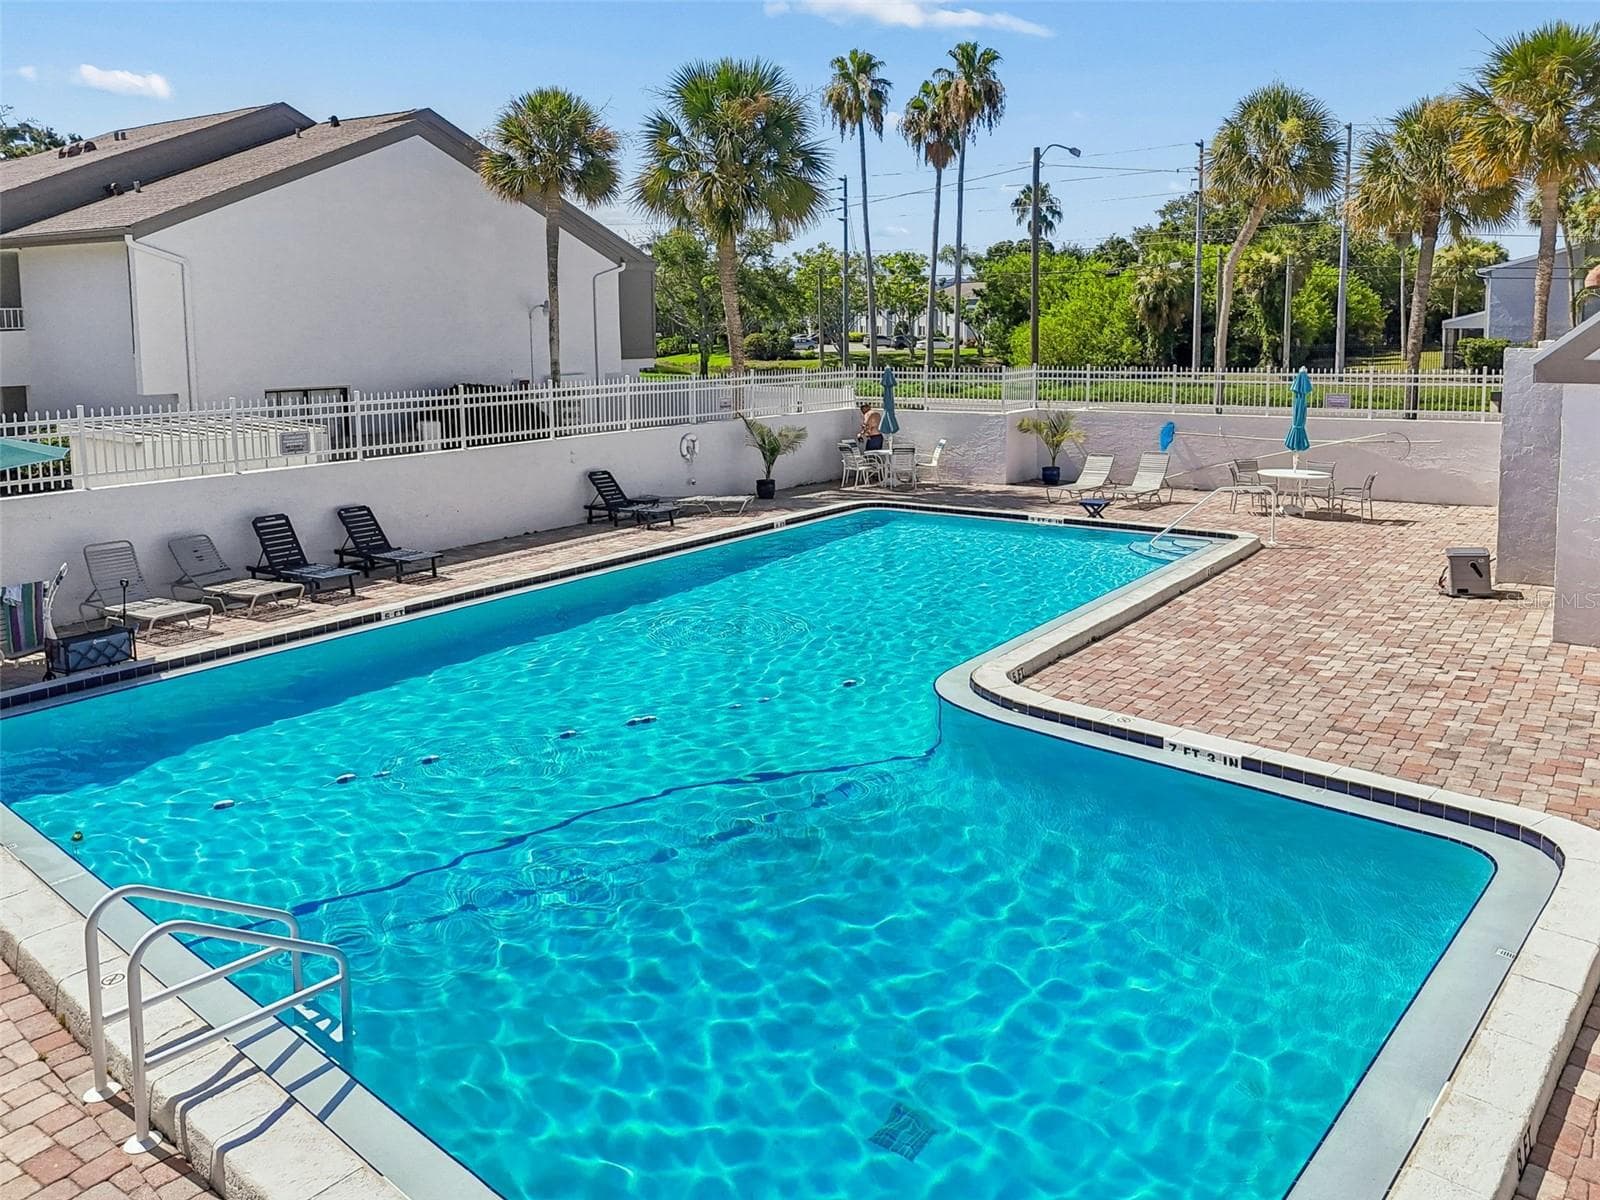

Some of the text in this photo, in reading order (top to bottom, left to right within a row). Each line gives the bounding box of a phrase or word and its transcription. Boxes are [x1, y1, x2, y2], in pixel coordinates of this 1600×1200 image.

[1168, 742, 1177, 752] 7
[1183, 746, 1200, 758] FT
[1223, 756, 1239, 769] IN
